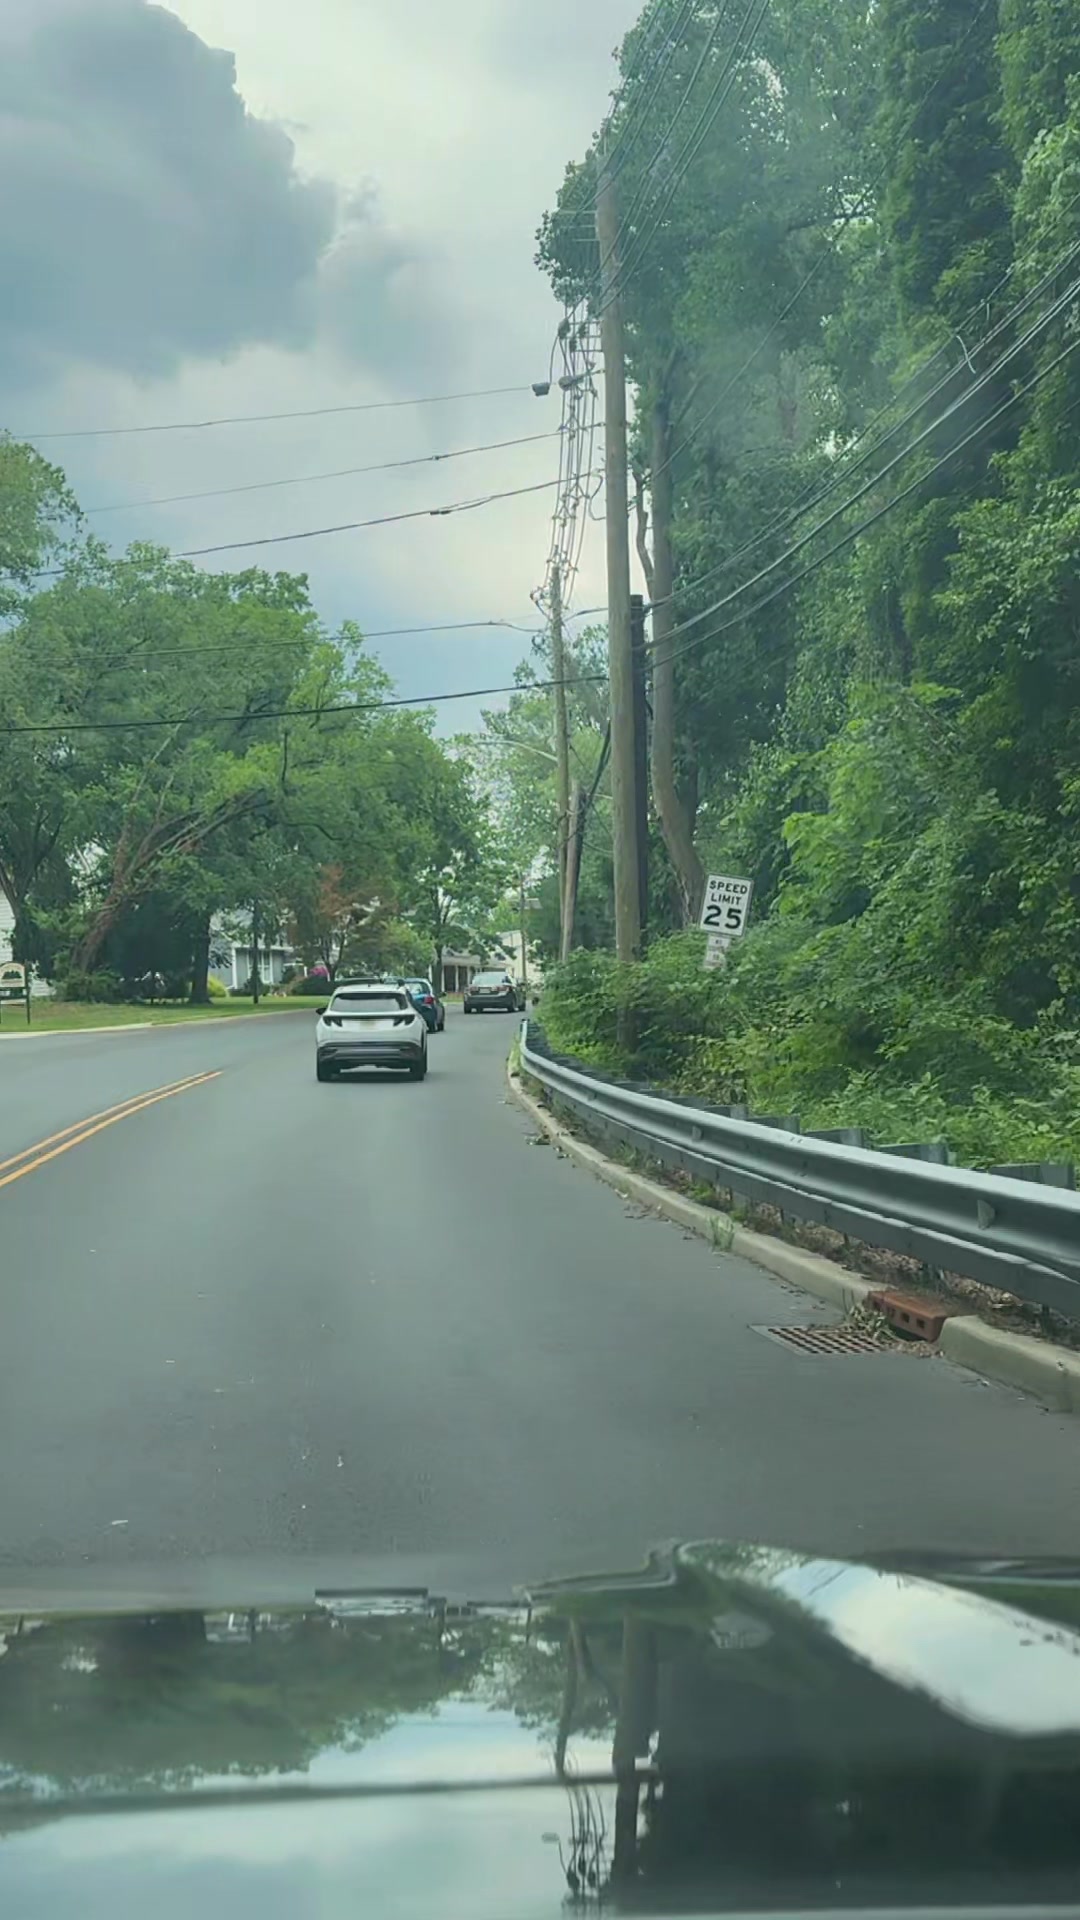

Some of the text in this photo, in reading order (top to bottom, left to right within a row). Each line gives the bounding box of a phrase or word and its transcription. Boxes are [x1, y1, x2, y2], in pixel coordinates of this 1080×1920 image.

[709, 880, 748, 895] SPEED
[711, 893, 742, 905] LIMIT
[703, 905, 742, 929] 25
